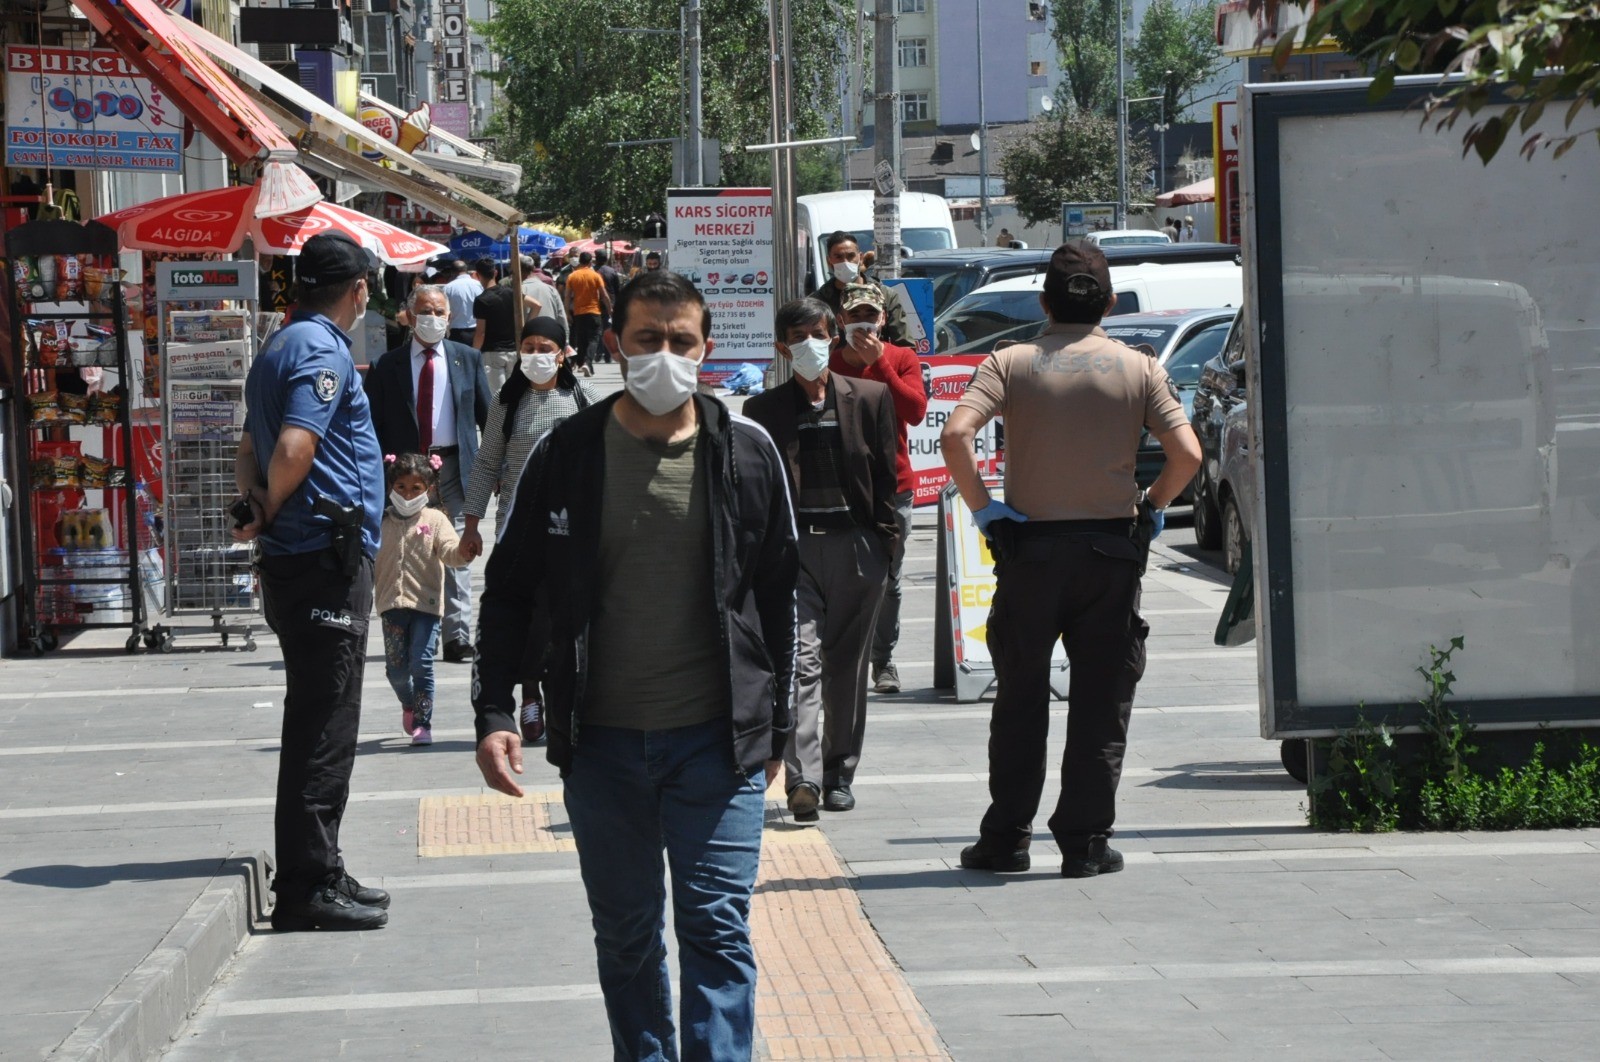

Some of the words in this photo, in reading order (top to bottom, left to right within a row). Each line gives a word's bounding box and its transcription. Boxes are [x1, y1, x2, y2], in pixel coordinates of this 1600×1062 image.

[11, 52, 141, 74] BURCU
[52, 88, 138, 119] LOTO
[11, 130, 119, 148] FOTOKOPİ
[137, 136, 176, 150] FAX
[131, 157, 175, 168] KEMER
[675, 206, 712, 218] KARS
[694, 221, 755, 236] MERKEZİ
[461, 237, 481, 248] Golf
[677, 239, 707, 248] Sigortan
[699, 248, 730, 256] Sigortan
[731, 248, 753, 256] yoksa
[173, 270, 236, 284] fotoMac
[722, 323, 746, 331] Şirketi
[730, 332, 749, 340] kolay
[751, 332, 772, 340] poliçe
[726, 341, 745, 349] Fiyat
[919, 475, 947, 486] Murat
